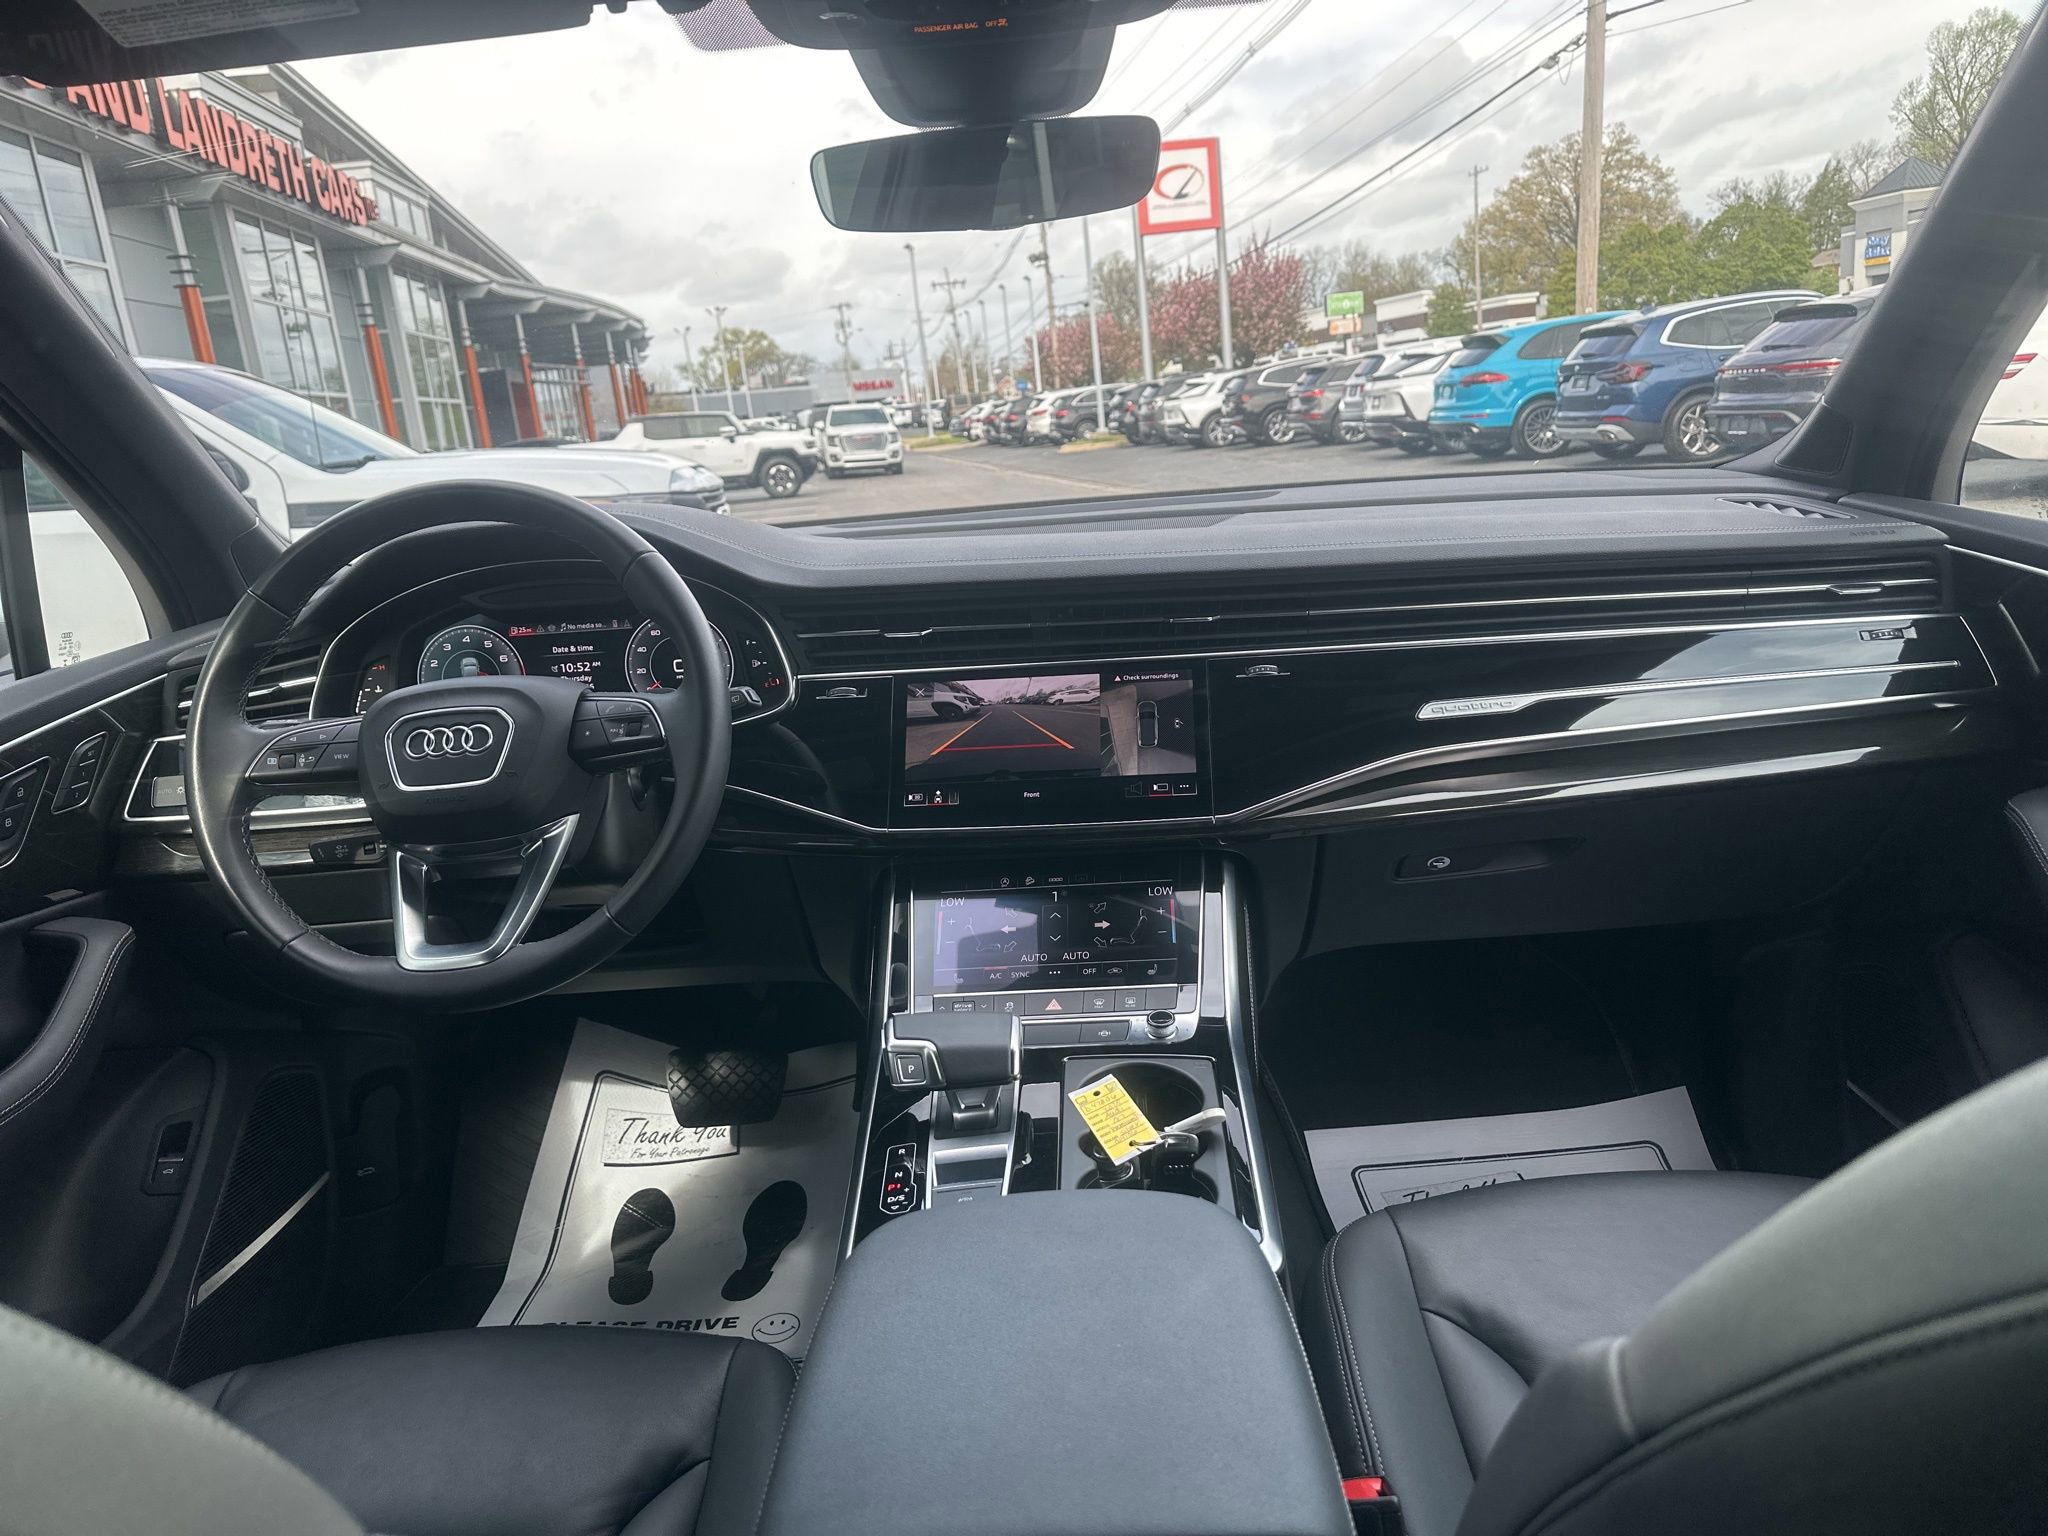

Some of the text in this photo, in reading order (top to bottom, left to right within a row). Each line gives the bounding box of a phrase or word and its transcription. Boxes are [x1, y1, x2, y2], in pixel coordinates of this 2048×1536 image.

[913, 24, 952, 33] PASSENGER
[952, 23, 964, 31] AIR
[964, 22, 978, 30] BAG
[155, 77, 311, 206] LANDRETH
[310, 155, 369, 227] CARS
[852, 378, 894, 391] NISSAN
[576, 622, 595, 630] media
[462, 635, 471, 643] 4
[484, 640, 493, 648] 5
[442, 643, 452, 651] 3
[552, 644, 594, 654] Date & time
[430, 659, 439, 668] 2
[499, 654, 509, 663] 6
[560, 661, 592, 673] 10:52
[560, 675, 593, 683] rsday
[1141, 672, 1179, 680] surroundings
[1431, 701, 1512, 714] quattro
[1023, 790, 1041, 799] Front
[1148, 885, 1173, 897] LOW
[940, 896, 966, 908] LOW
[1051, 891, 1059, 903] 1
[1020, 951, 1090, 962] AUTO AUTO
[989, 972, 1003, 980] A/C
[1010, 971, 1031, 979] SYNC
[1082, 967, 1098, 976] OFF
[908, 1064, 915, 1074] P
[618, 1117, 727, 1145] Thank You
[631, 1147, 647, 1159] For
[649, 1147, 668, 1159] Your
[887, 1194, 905, 1203] D/S
[656, 1316, 740, 1332] DRIVE
